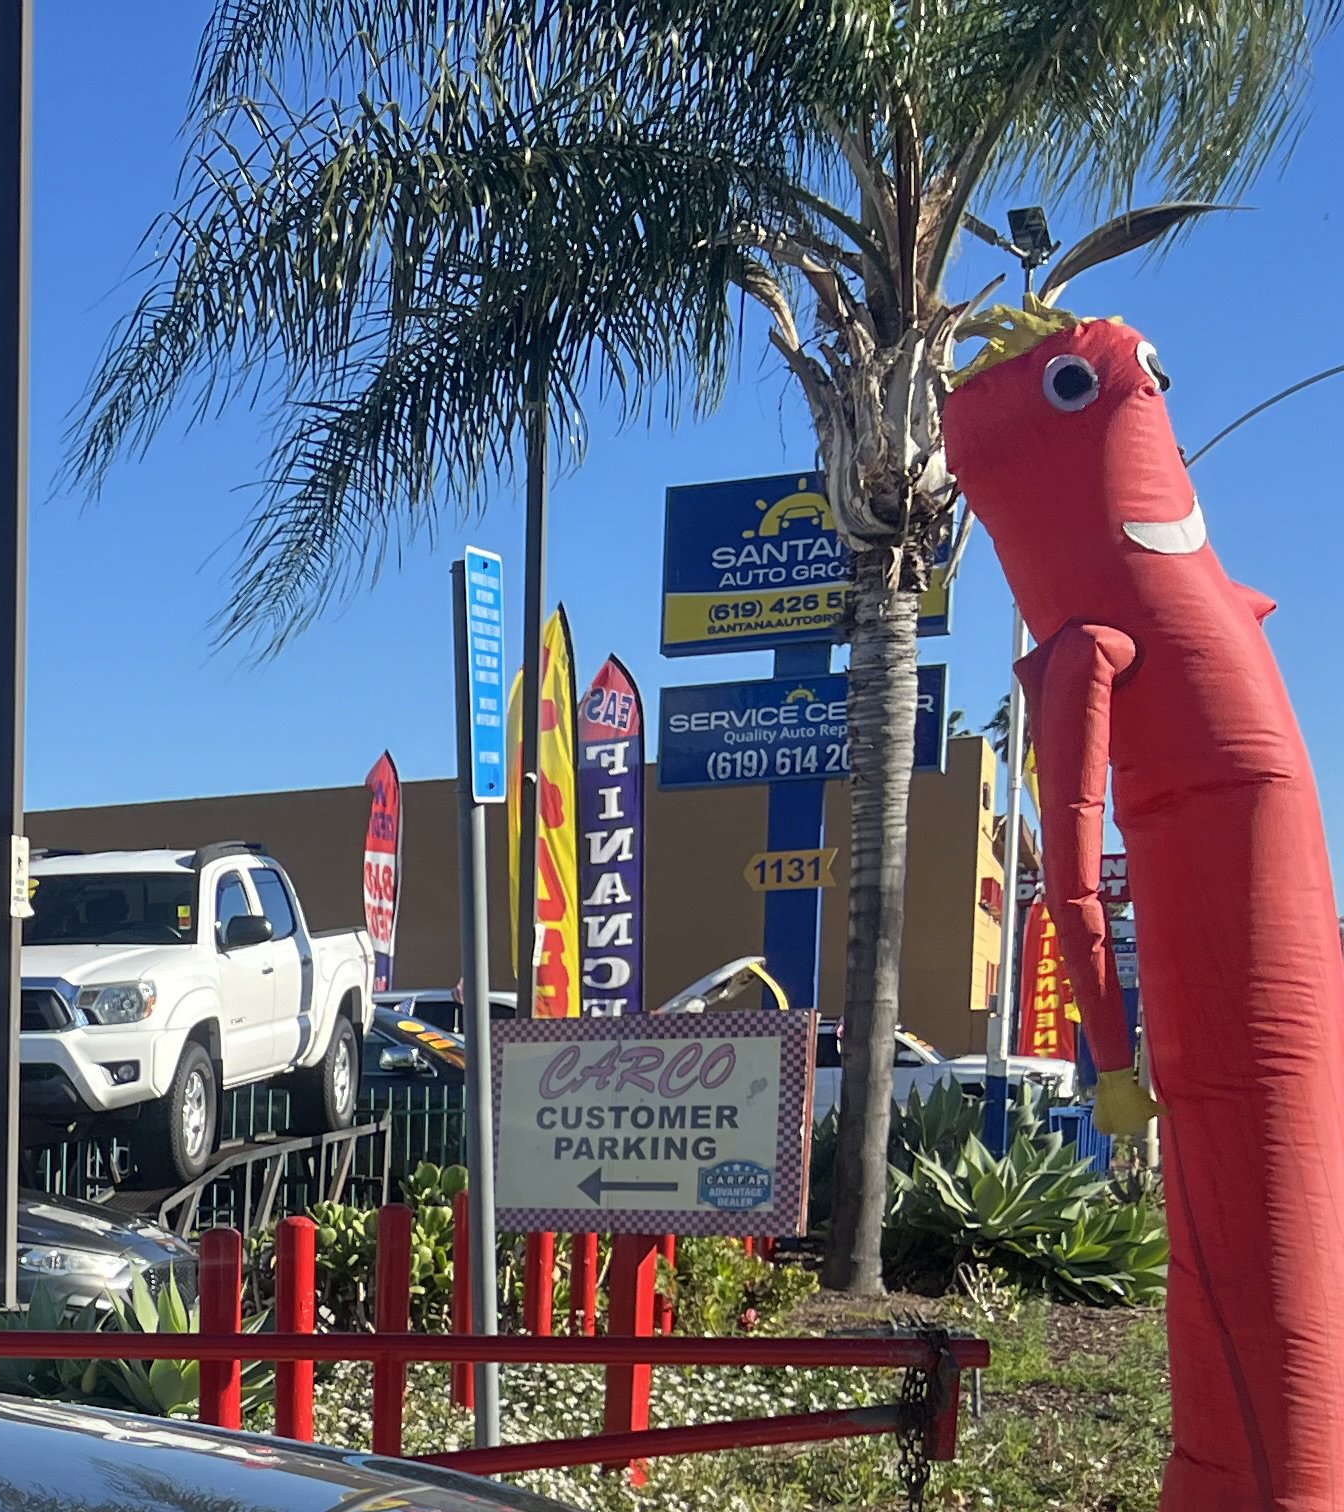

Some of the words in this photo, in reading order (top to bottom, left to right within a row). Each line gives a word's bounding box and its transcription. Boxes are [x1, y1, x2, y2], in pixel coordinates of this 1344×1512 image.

[712, 537, 843, 569] SANTA
[718, 569, 786, 588] AUTO
[792, 562, 854, 578] GROU
[709, 600, 763, 623] (619)
[769, 594, 820, 615] 426
[669, 705, 799, 733] SERVICE
[724, 728, 776, 745] Quality
[779, 726, 815, 740] Auto
[820, 724, 848, 739] Rep
[707, 750, 768, 780] (619)
[775, 746, 818, 775] 614
[825, 744, 850, 772] 20
[753, 856, 822, 885] 1131
[538, 1040, 736, 1100] CARCO
[537, 1105, 740, 1130] CUSTOMER
[554, 1136, 717, 1161] PARKING
[708, 1187, 763, 1197] ADVANTAGE
[717, 1198, 753, 1207] DEALER
